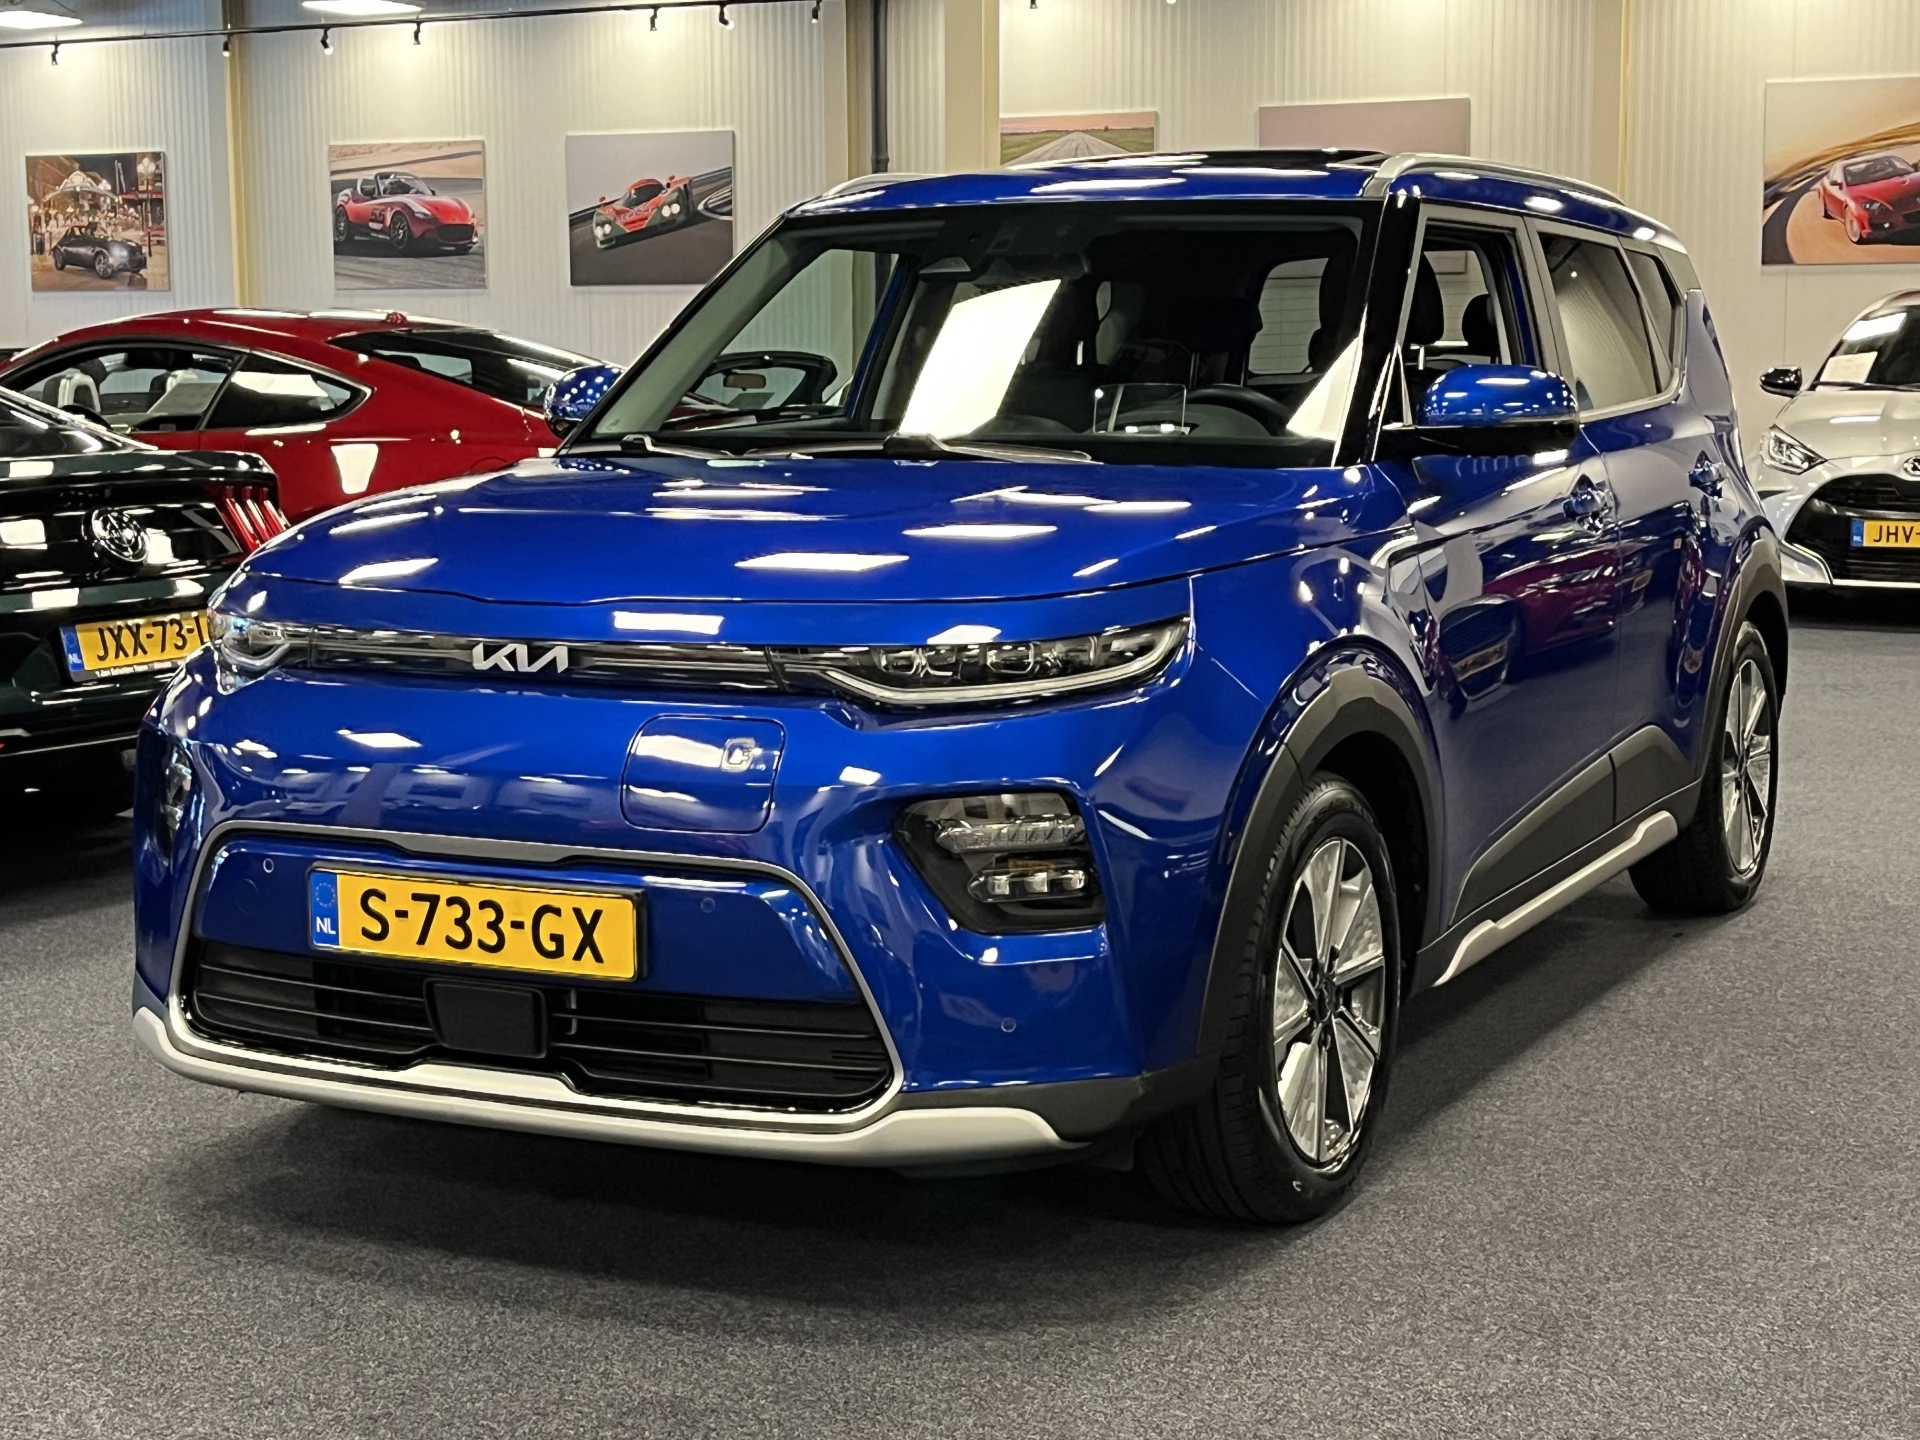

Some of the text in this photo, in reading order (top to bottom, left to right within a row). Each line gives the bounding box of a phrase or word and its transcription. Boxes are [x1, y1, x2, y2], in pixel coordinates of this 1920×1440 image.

[472, 642, 568, 674] KIA
[316, 917, 336, 935] NL
[360, 888, 604, 964] S-733-GX
